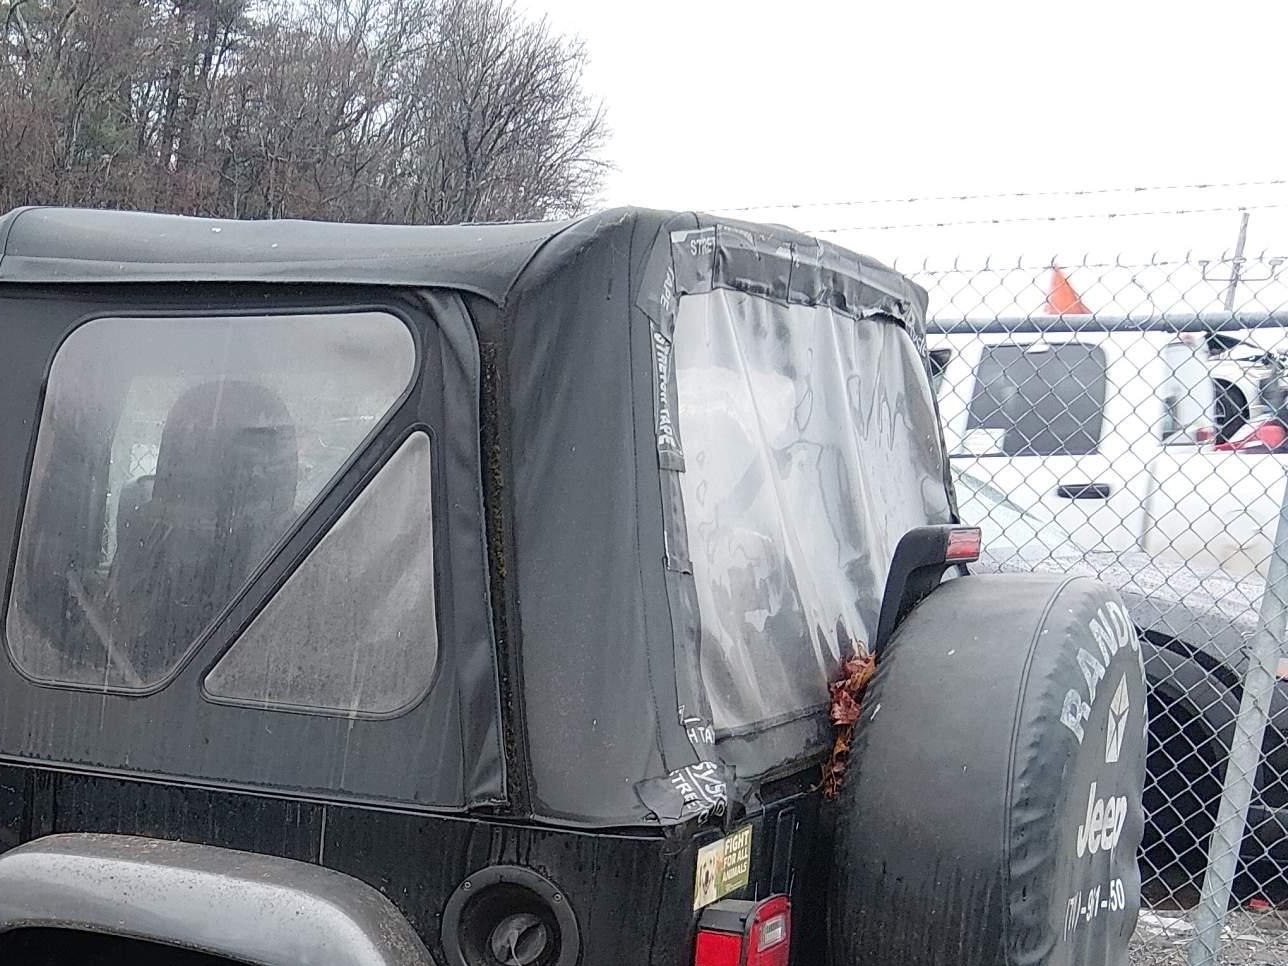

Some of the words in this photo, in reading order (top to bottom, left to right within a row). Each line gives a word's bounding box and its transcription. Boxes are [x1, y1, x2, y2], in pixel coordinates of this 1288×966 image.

[1076, 782, 1127, 858] Jeep
[725, 830, 750, 855] FIGHT
[724, 853, 737, 869] FOR
[737, 847, 749, 862] ALL
[723, 862, 747, 881] ANIMALS
